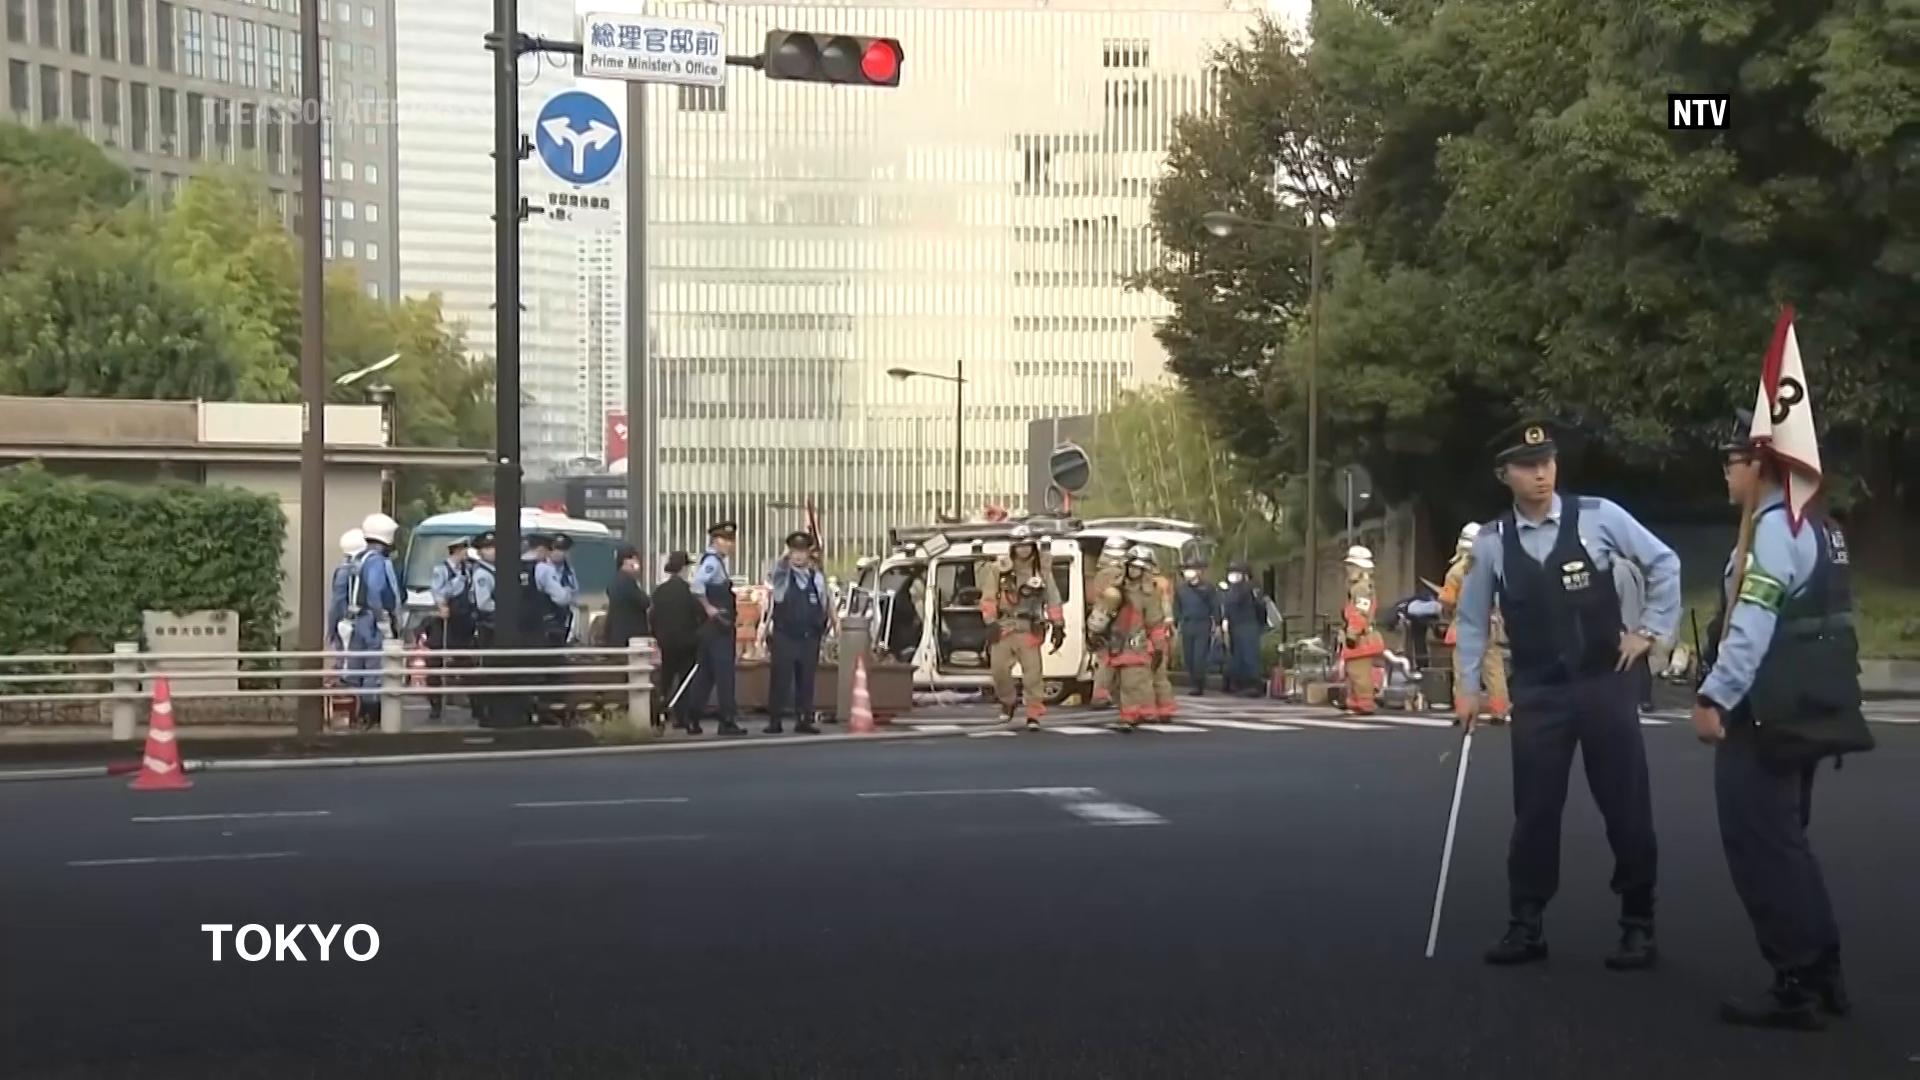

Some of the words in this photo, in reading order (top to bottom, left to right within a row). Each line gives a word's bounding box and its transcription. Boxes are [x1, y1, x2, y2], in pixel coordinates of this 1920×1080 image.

[591, 22, 719, 56] 総理官邸前
[591, 53, 624, 69] Prime
[627, 57, 681, 73] Minister's
[685, 60, 718, 75] Office
[1771, 377, 1804, 424] 3
